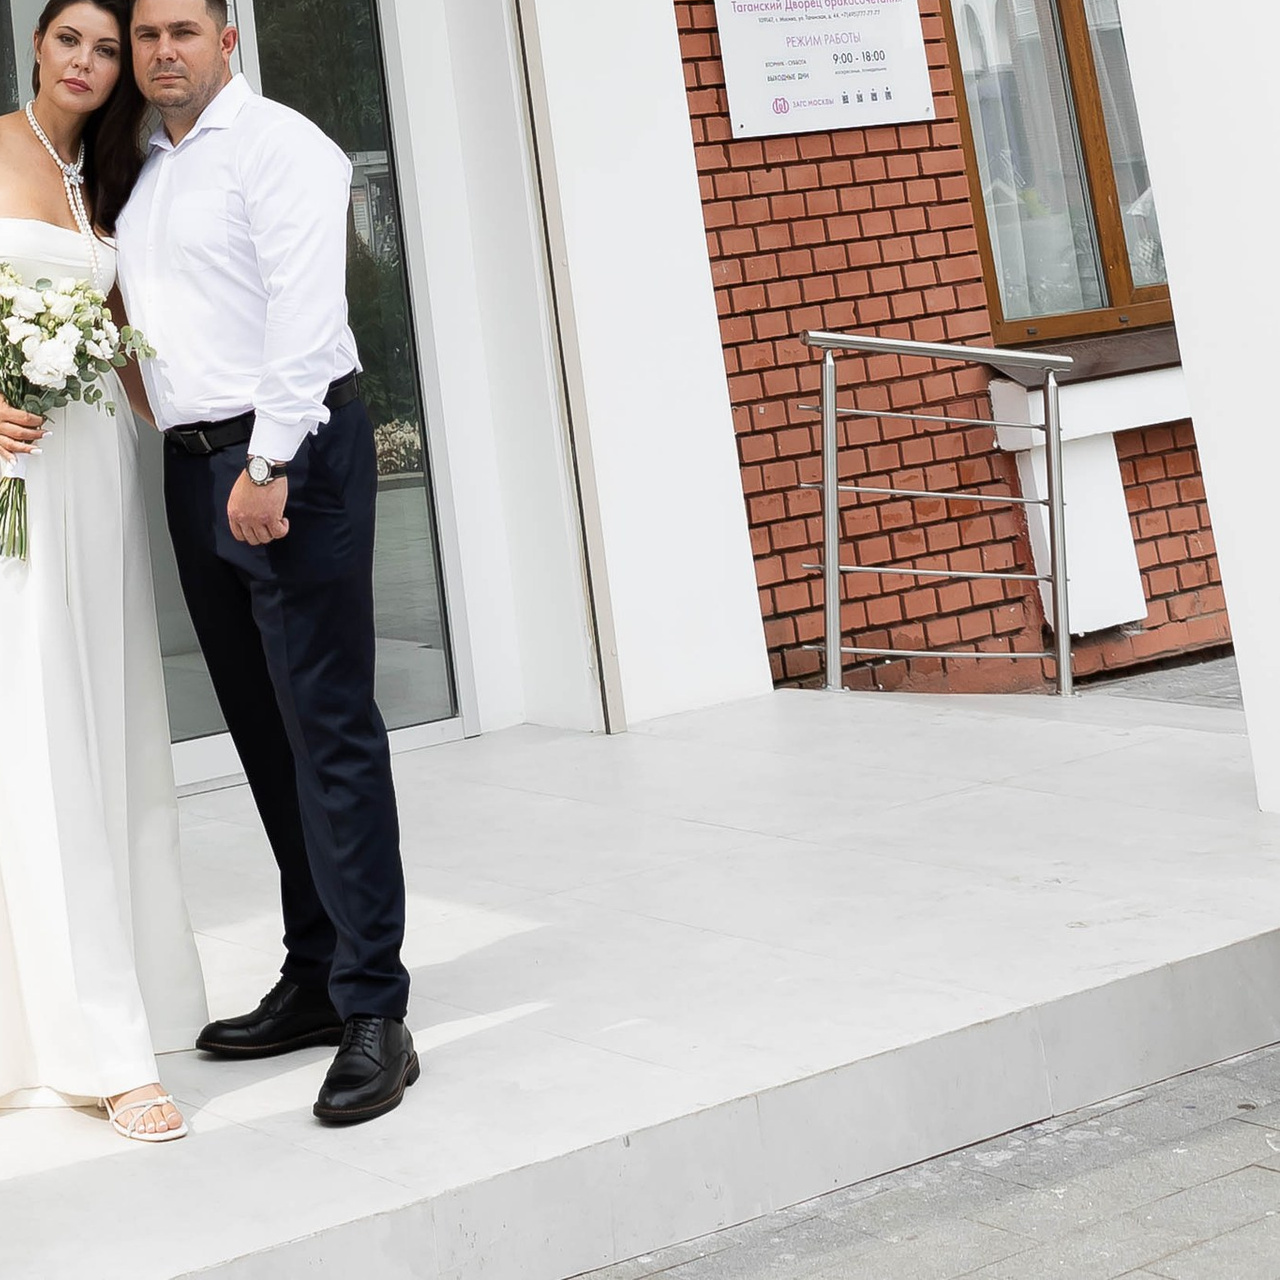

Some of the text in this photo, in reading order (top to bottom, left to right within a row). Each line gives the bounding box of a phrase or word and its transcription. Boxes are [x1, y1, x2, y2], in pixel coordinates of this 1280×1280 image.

[731, 0, 782, 13] Таганский
[786, 32, 861, 48] РЕЖИМ РАБОТЫ
[832, 52, 853, 65] 9:00
[862, 50, 886, 63] 18:00
